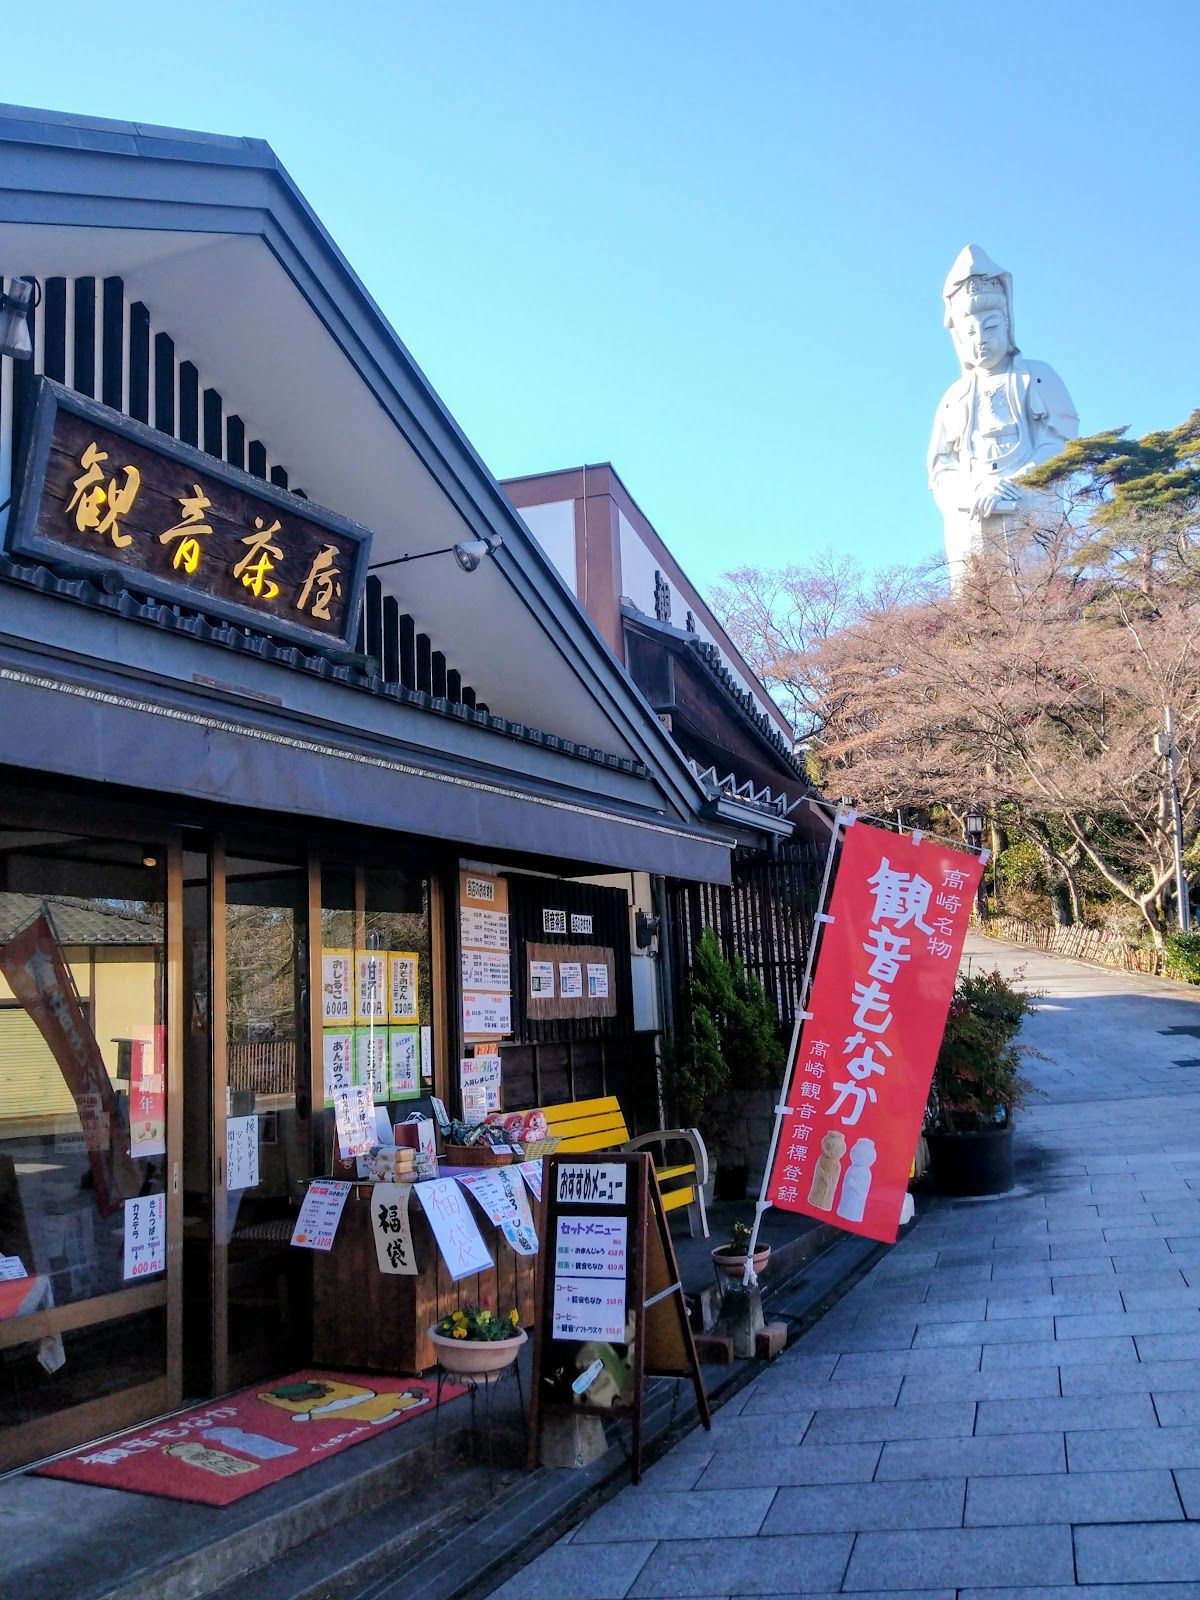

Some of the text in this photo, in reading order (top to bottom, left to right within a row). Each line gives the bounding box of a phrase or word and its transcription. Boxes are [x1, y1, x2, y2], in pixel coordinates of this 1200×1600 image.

[65, 441, 342, 621] 観音茶屋
[544, 911, 565, 932] 観音茶屋
[926, 868, 970, 960] 高崎名物
[332, 959, 343, 1000] おしるこ
[399, 962, 408, 1000] みそおでん
[825, 856, 935, 1126] 観音もなか
[326, 1000, 348, 1015] 600円
[394, 1003, 413, 1014] 330円
[333, 1040, 343, 1083] あんみつ
[776, 1039, 831, 1203] 高崎観音商標登録
[560, 1168, 623, 1200] おすすめメニュー
[132, 1203, 140, 1240] カステラ
[148, 1200, 156, 1236] きんつば
[560, 1222, 622, 1235] セットメニュー
[378, 1204, 408, 1269] 福袋
[132, 1261, 157, 1275] 600円
[607, 1263, 624, 1271] 450円
[556, 1284, 578, 1292] コーヒー
[555, 1312, 578, 1321] コーヒー
[77, 1406, 238, 1465] 観音もなか
